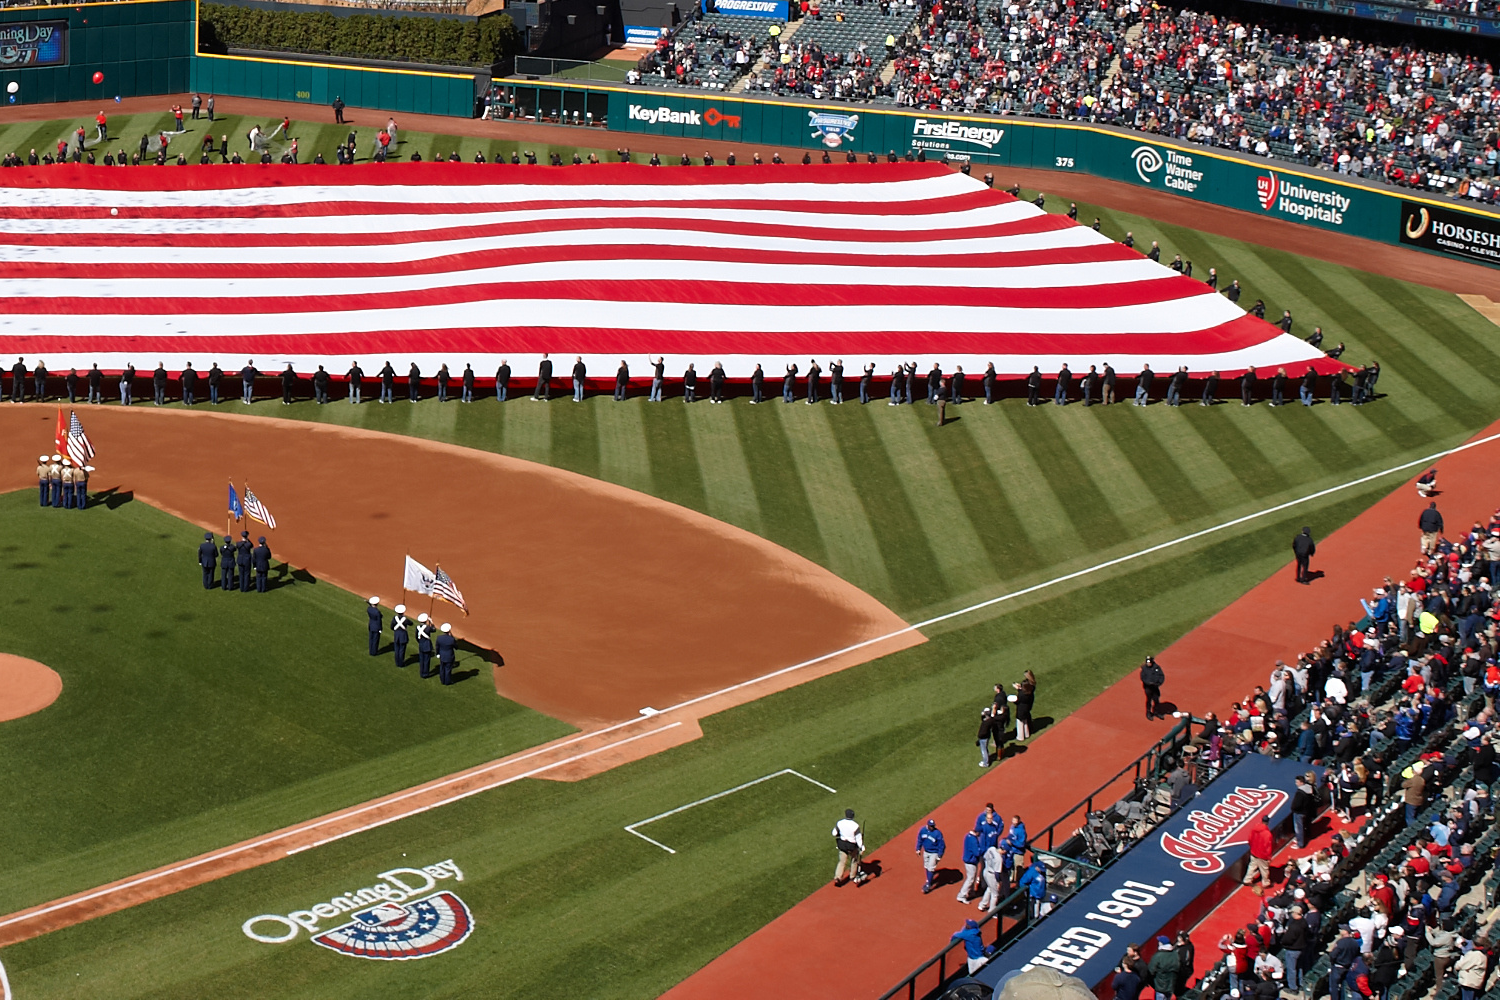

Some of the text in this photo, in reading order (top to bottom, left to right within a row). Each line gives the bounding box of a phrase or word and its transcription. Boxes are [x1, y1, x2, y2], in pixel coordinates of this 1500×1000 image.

[714, 0, 778, 12] PROGRESSIVE
[24, 25, 53, 41] Day
[628, 105, 700, 125] KeyBank
[913, 119, 1004, 144] FirstEnergy
[911, 140, 950, 149] Solutions
[1056, 157, 1074, 167] 375
[1166, 151, 1193, 167] Time
[1166, 165, 1204, 181] Warner
[1164, 175, 1197, 192] Cable
[1258, 180, 1268, 190] UH
[1280, 181, 1350, 212] University
[1279, 197, 1343, 225] Hospitals
[1432, 221, 1500, 248] HORSESH
[1437, 238, 1464, 249] CASINO
[1160, 785, 1289, 875] Indians
[242, 859, 464, 943] Opening Day
[1085, 880, 1175, 928] 1901.
